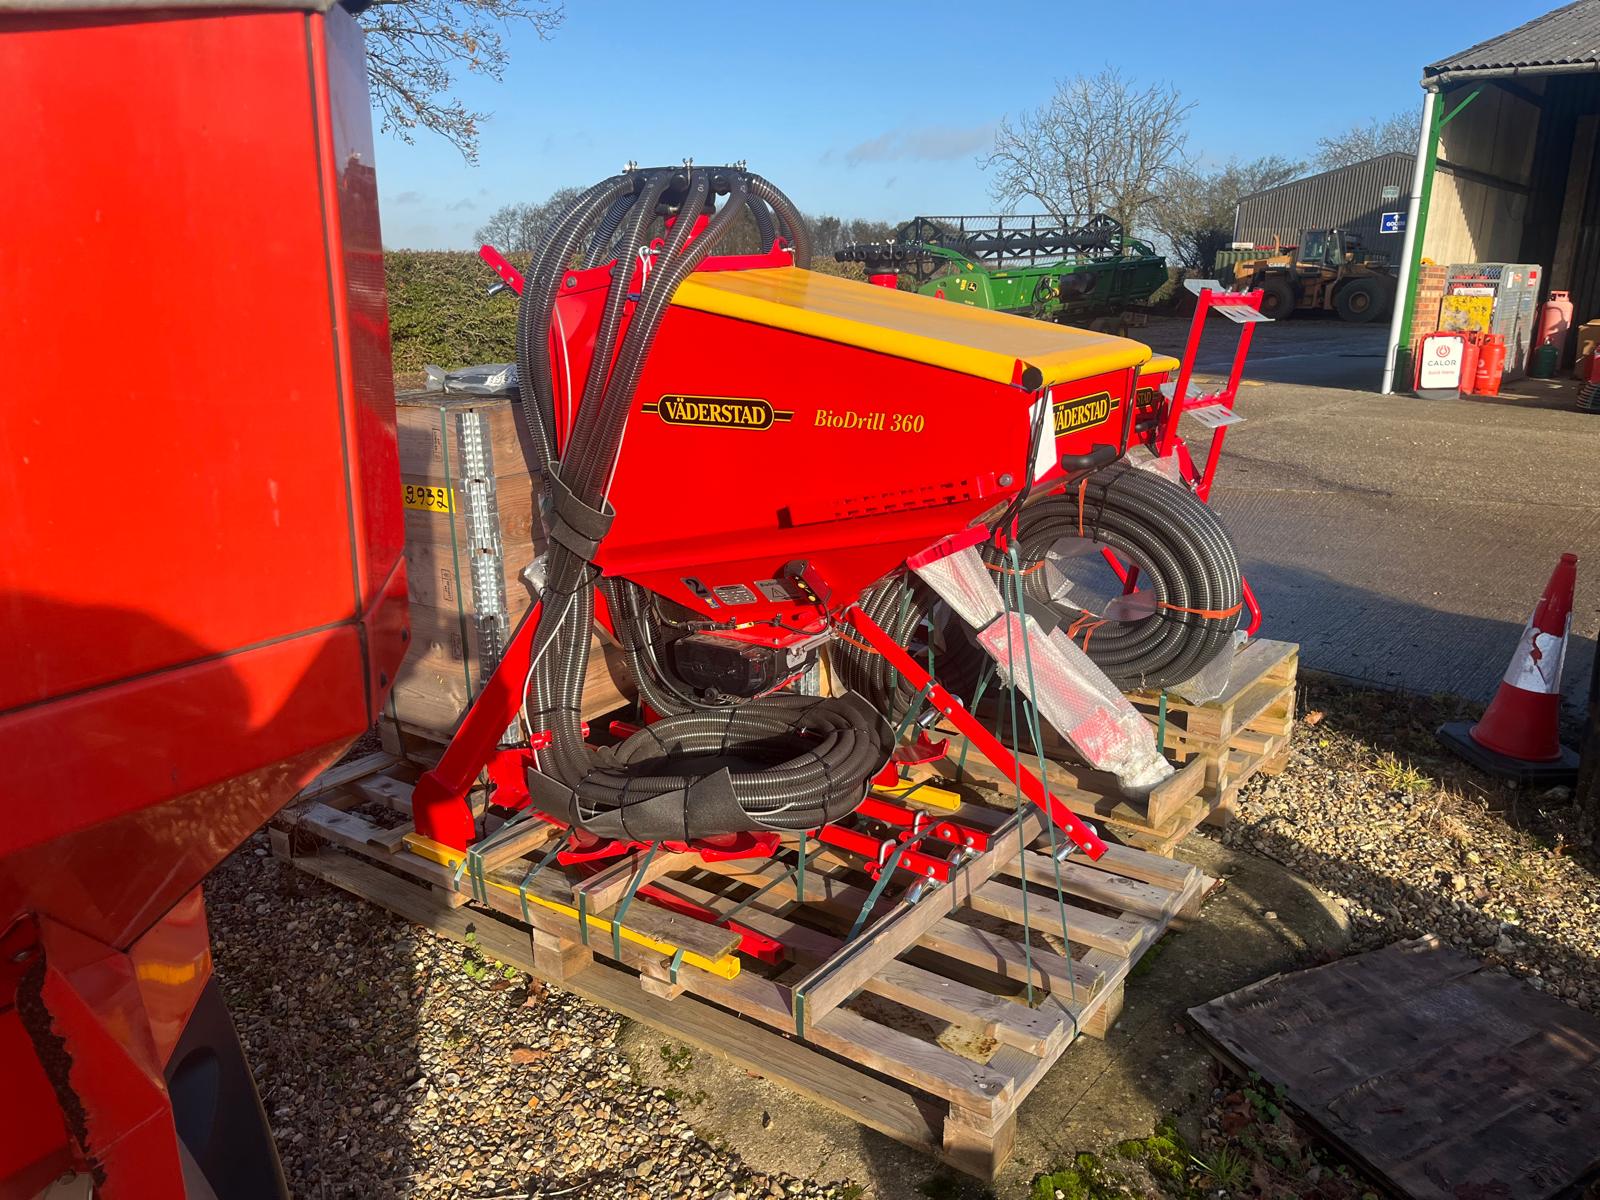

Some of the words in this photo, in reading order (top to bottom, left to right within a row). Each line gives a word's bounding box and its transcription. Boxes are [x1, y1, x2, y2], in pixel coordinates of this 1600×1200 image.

[665, 397, 766, 425] VÄDERSTAD
[814, 409, 886, 431] BioDrill
[890, 413, 925, 433] 360
